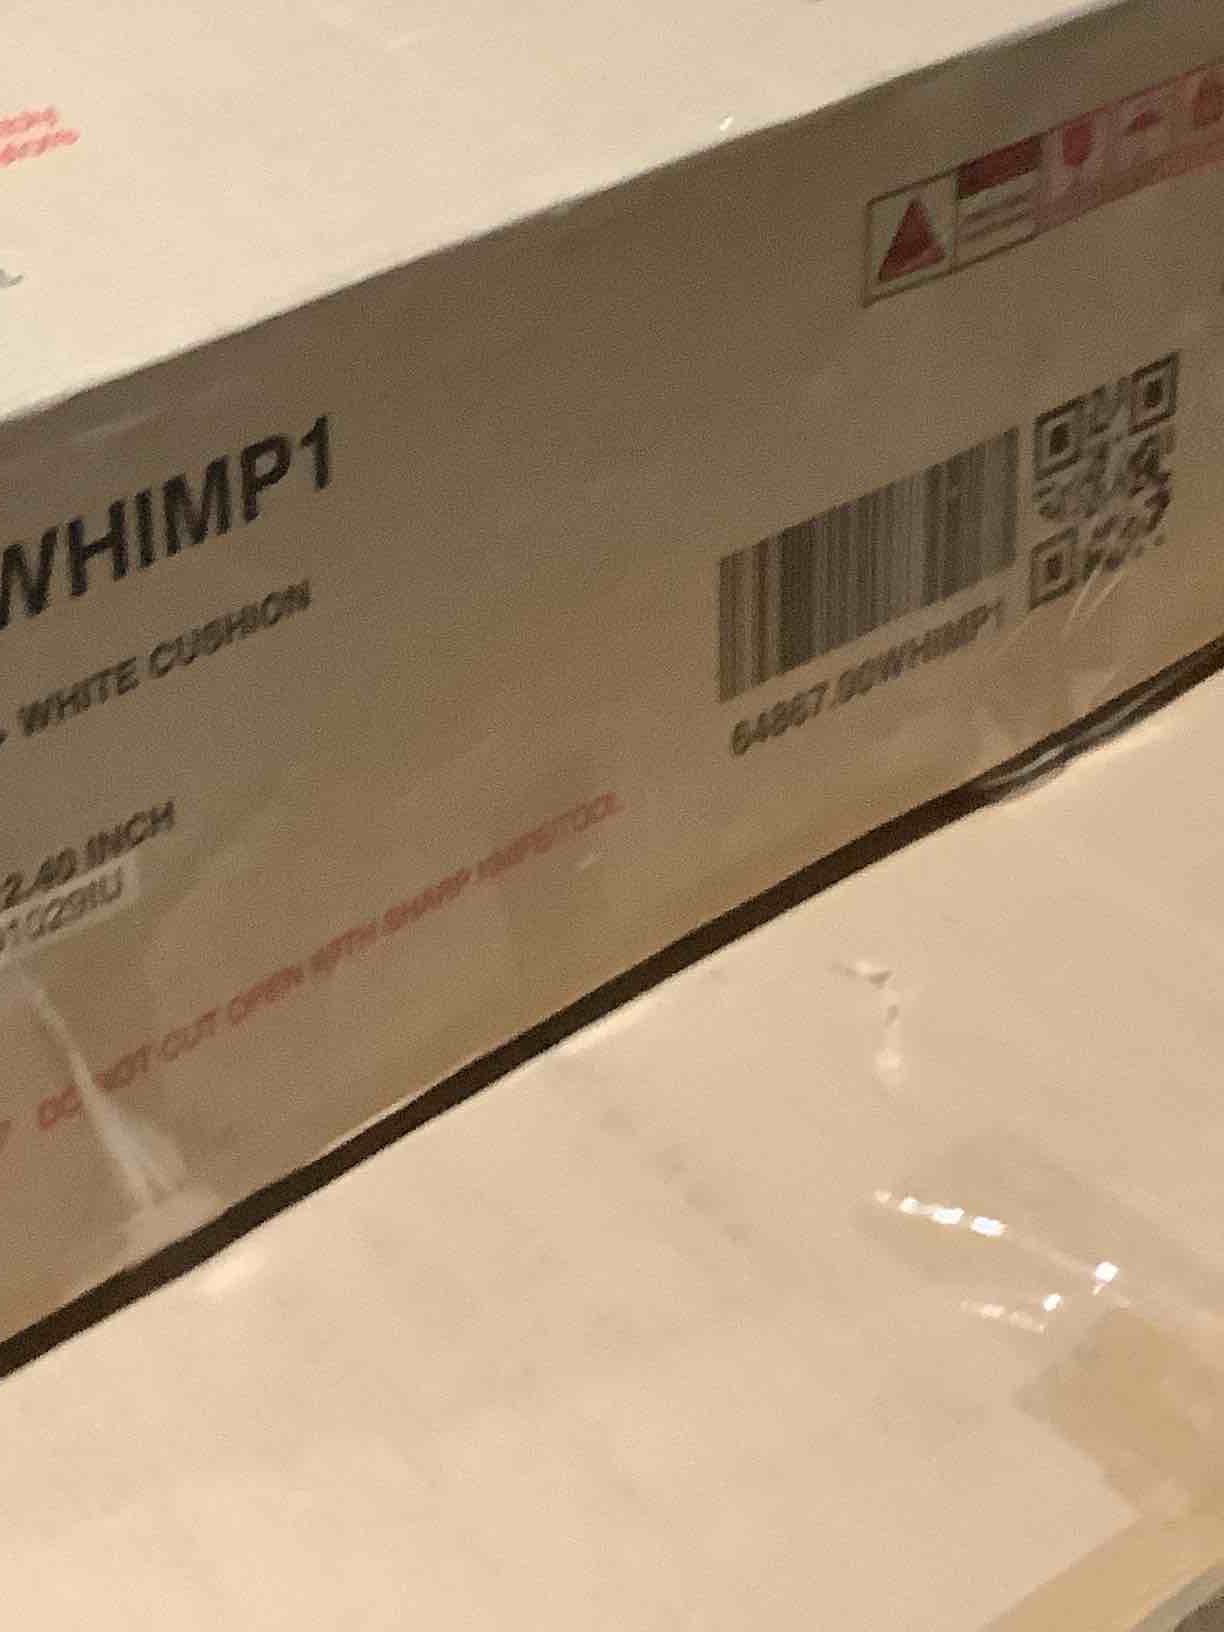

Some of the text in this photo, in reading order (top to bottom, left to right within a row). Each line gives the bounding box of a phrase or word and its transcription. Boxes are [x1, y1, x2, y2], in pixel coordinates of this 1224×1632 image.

[17, 657, 141, 738] WHITE
[147, 578, 314, 680] CUSHION
[84, 798, 177, 869] INCH
[159, 1008, 219, 1062] CUT
[380, 868, 474, 937] SHARP
